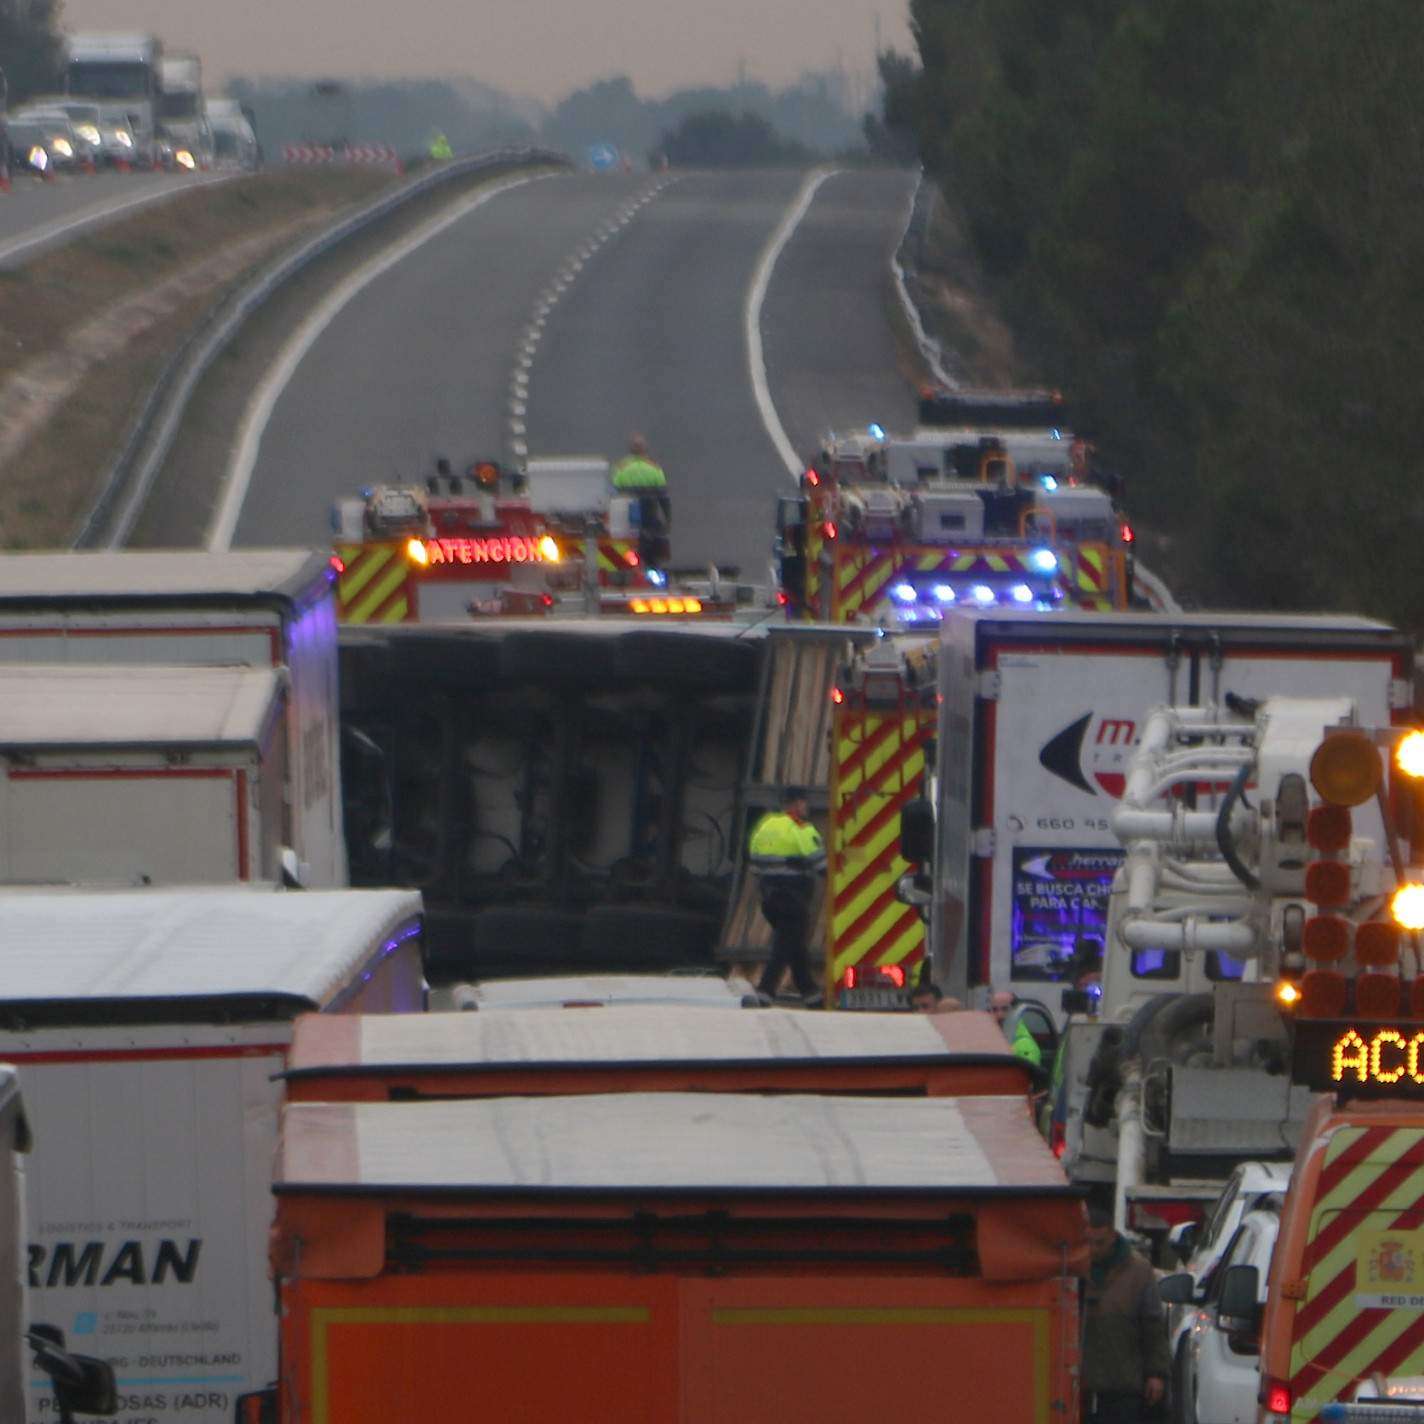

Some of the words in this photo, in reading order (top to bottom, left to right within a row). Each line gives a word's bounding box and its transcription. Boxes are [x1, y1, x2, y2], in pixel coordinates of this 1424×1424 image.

[1036, 817, 1074, 831] 660
[1017, 882, 1033, 896] SE
[1036, 883, 1083, 897] BUSCA
[1030, 897, 1067, 909] PARA
[1381, 1296, 1405, 1306] RED
[138, 1355, 241, 1368] DEUTSCHLAND
[175, 1392, 228, 1410] (ADR)
